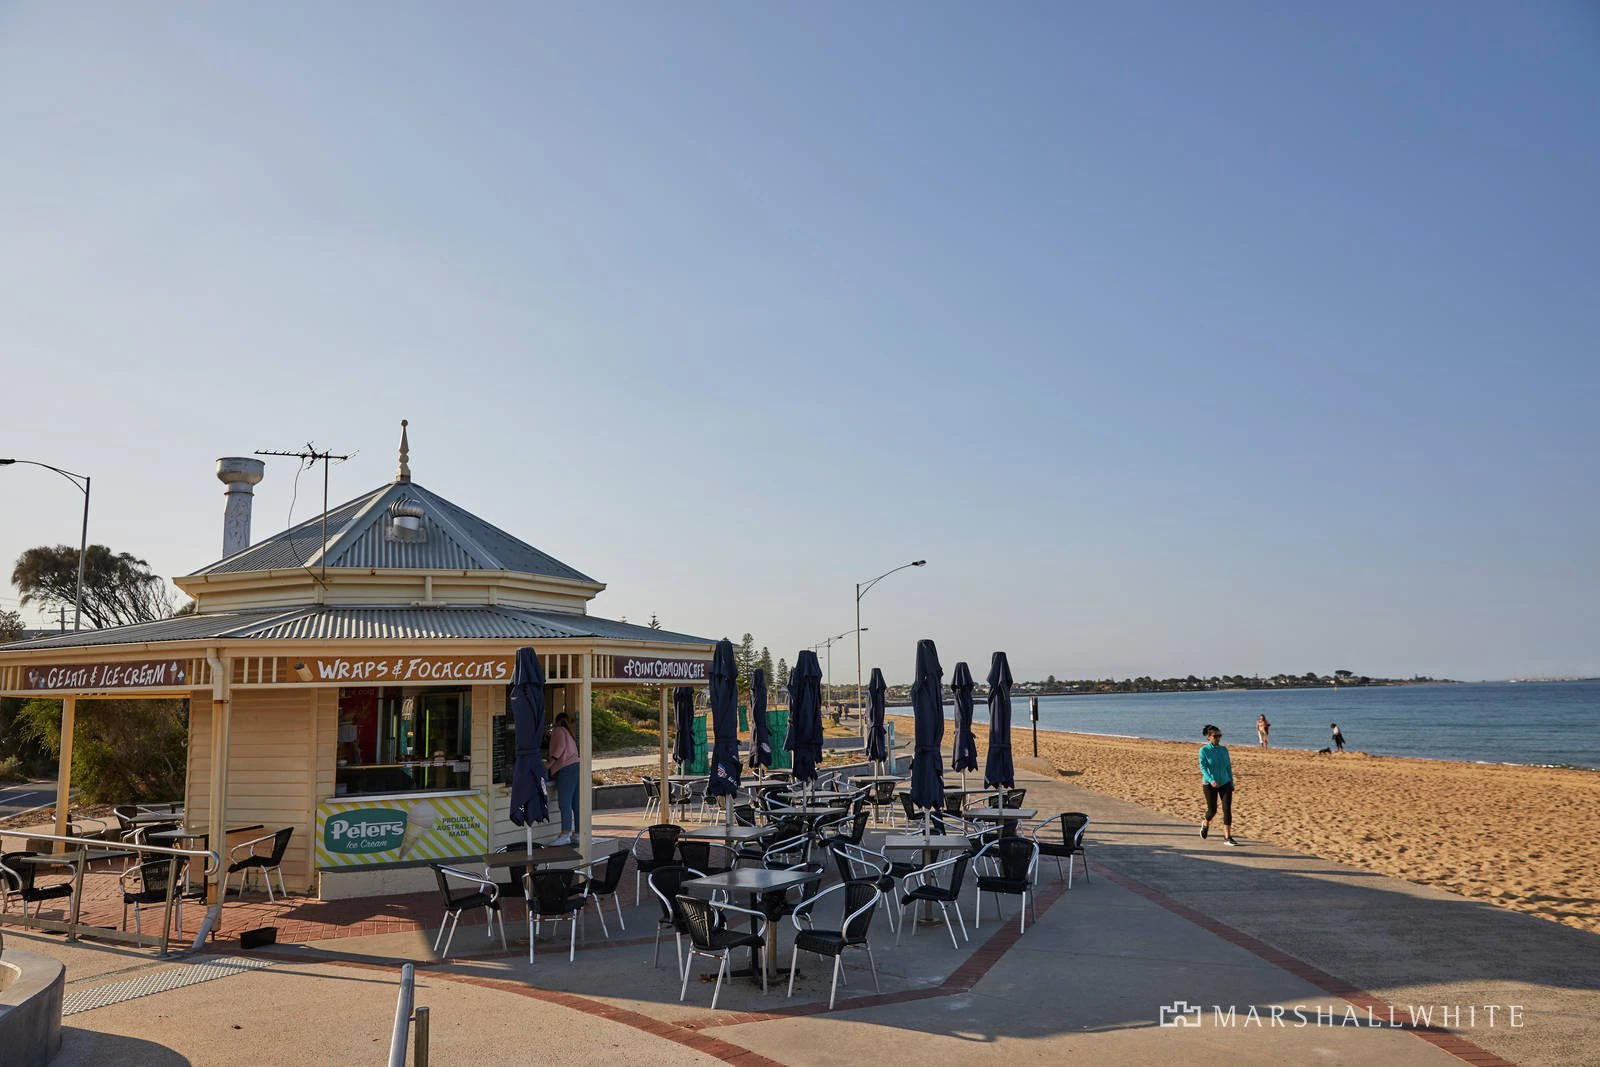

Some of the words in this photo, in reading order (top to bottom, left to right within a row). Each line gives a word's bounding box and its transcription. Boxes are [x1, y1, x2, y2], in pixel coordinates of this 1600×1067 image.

[48, 668, 87, 688] GELATI
[89, 666, 97, 686] &
[100, 664, 166, 686] ICE-CREAM
[317, 658, 388, 680] WRAPS
[392, 658, 404, 680] &
[404, 658, 507, 680] FOCACCIAS
[623, 658, 654, 677] POINT
[330, 820, 404, 840] Peters
[436, 822, 480, 831] AUSTRALIAN
[346, 840, 358, 850] Ice
[360, 840, 388, 849] Cream
